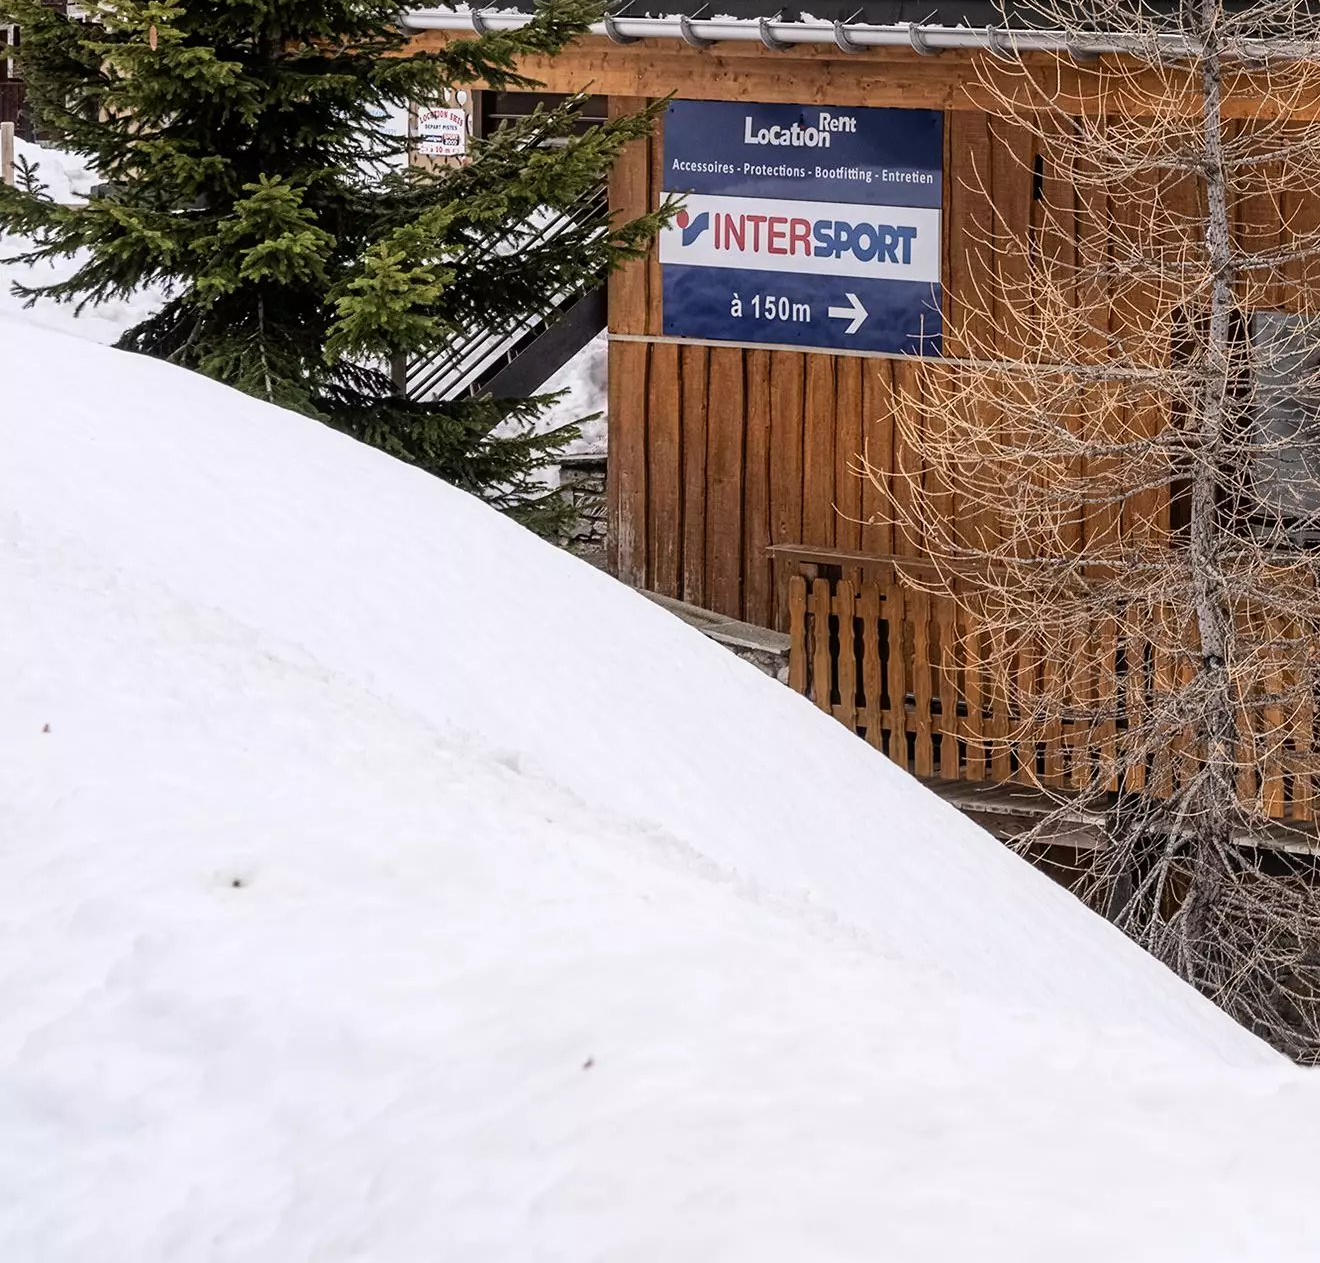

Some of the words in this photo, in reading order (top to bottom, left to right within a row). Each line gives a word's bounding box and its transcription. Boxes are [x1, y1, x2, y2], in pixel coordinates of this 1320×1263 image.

[450, 113, 463, 126] SKIS
[744, 116, 831, 147] Location
[819, 112, 857, 133] Rent
[672, 158, 735, 174] Accessoires
[743, 163, 806, 178] Protections
[814, 167, 872, 183] Bootfitting
[882, 169, 933, 184] Entretien
[714, 212, 917, 265] INTERSPORT
[730, 293, 743, 318] à
[751, 294, 811, 323] 150m
